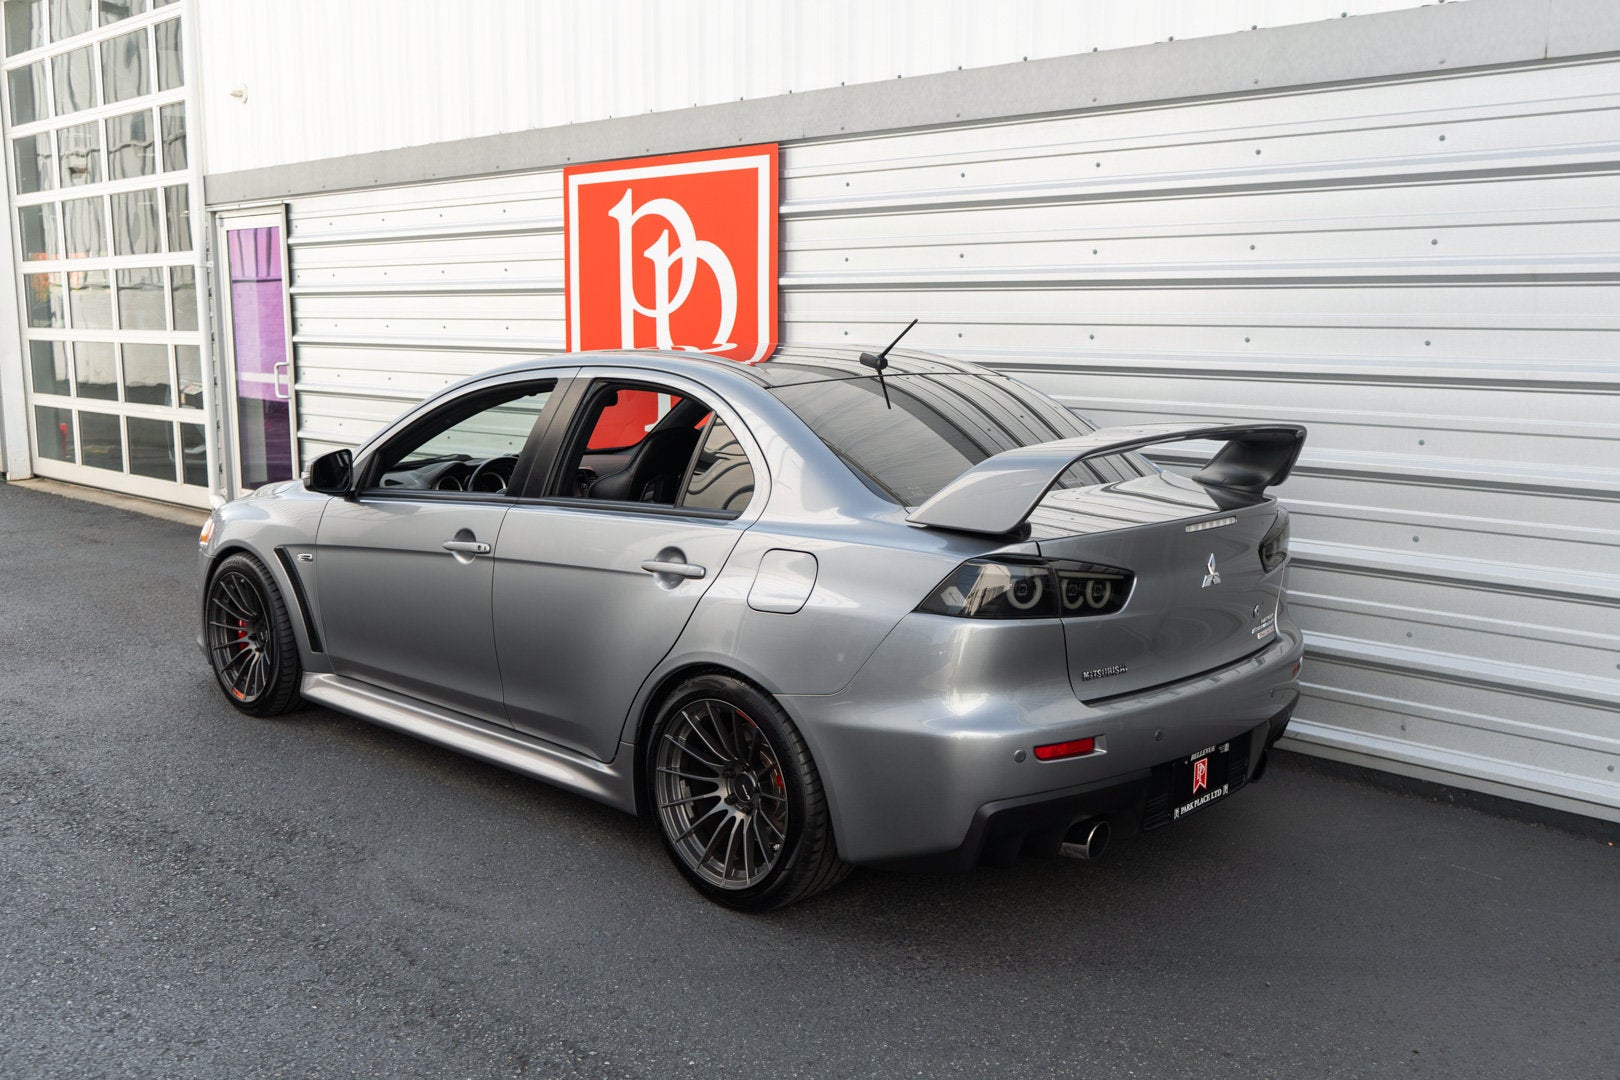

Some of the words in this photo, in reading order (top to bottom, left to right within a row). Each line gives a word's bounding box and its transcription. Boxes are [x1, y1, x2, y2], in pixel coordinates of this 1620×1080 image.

[1180, 802, 1194, 815] PARK
[1194, 793, 1211, 807] PLACE
[1211, 788, 1222, 799] LTD
